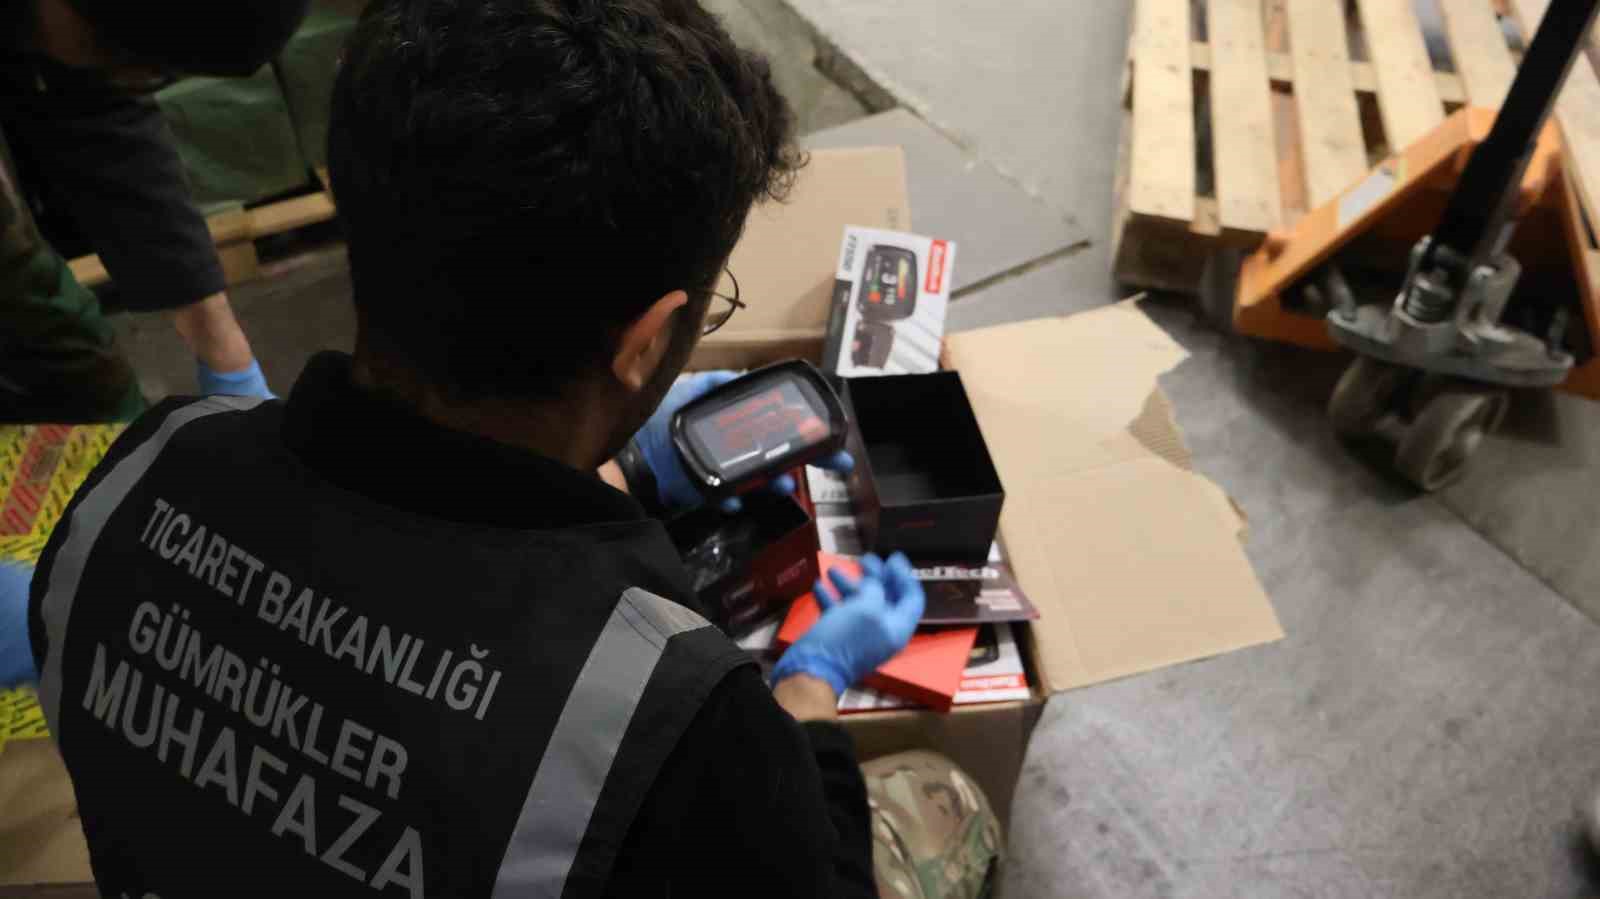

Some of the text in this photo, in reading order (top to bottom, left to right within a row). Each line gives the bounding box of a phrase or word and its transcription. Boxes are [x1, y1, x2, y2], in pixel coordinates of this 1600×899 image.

[128, 601, 408, 799] GÜMRÜKLER
[257, 570, 501, 720] BAKANLIĞI
[82, 642, 425, 899] MUHAFAZA
